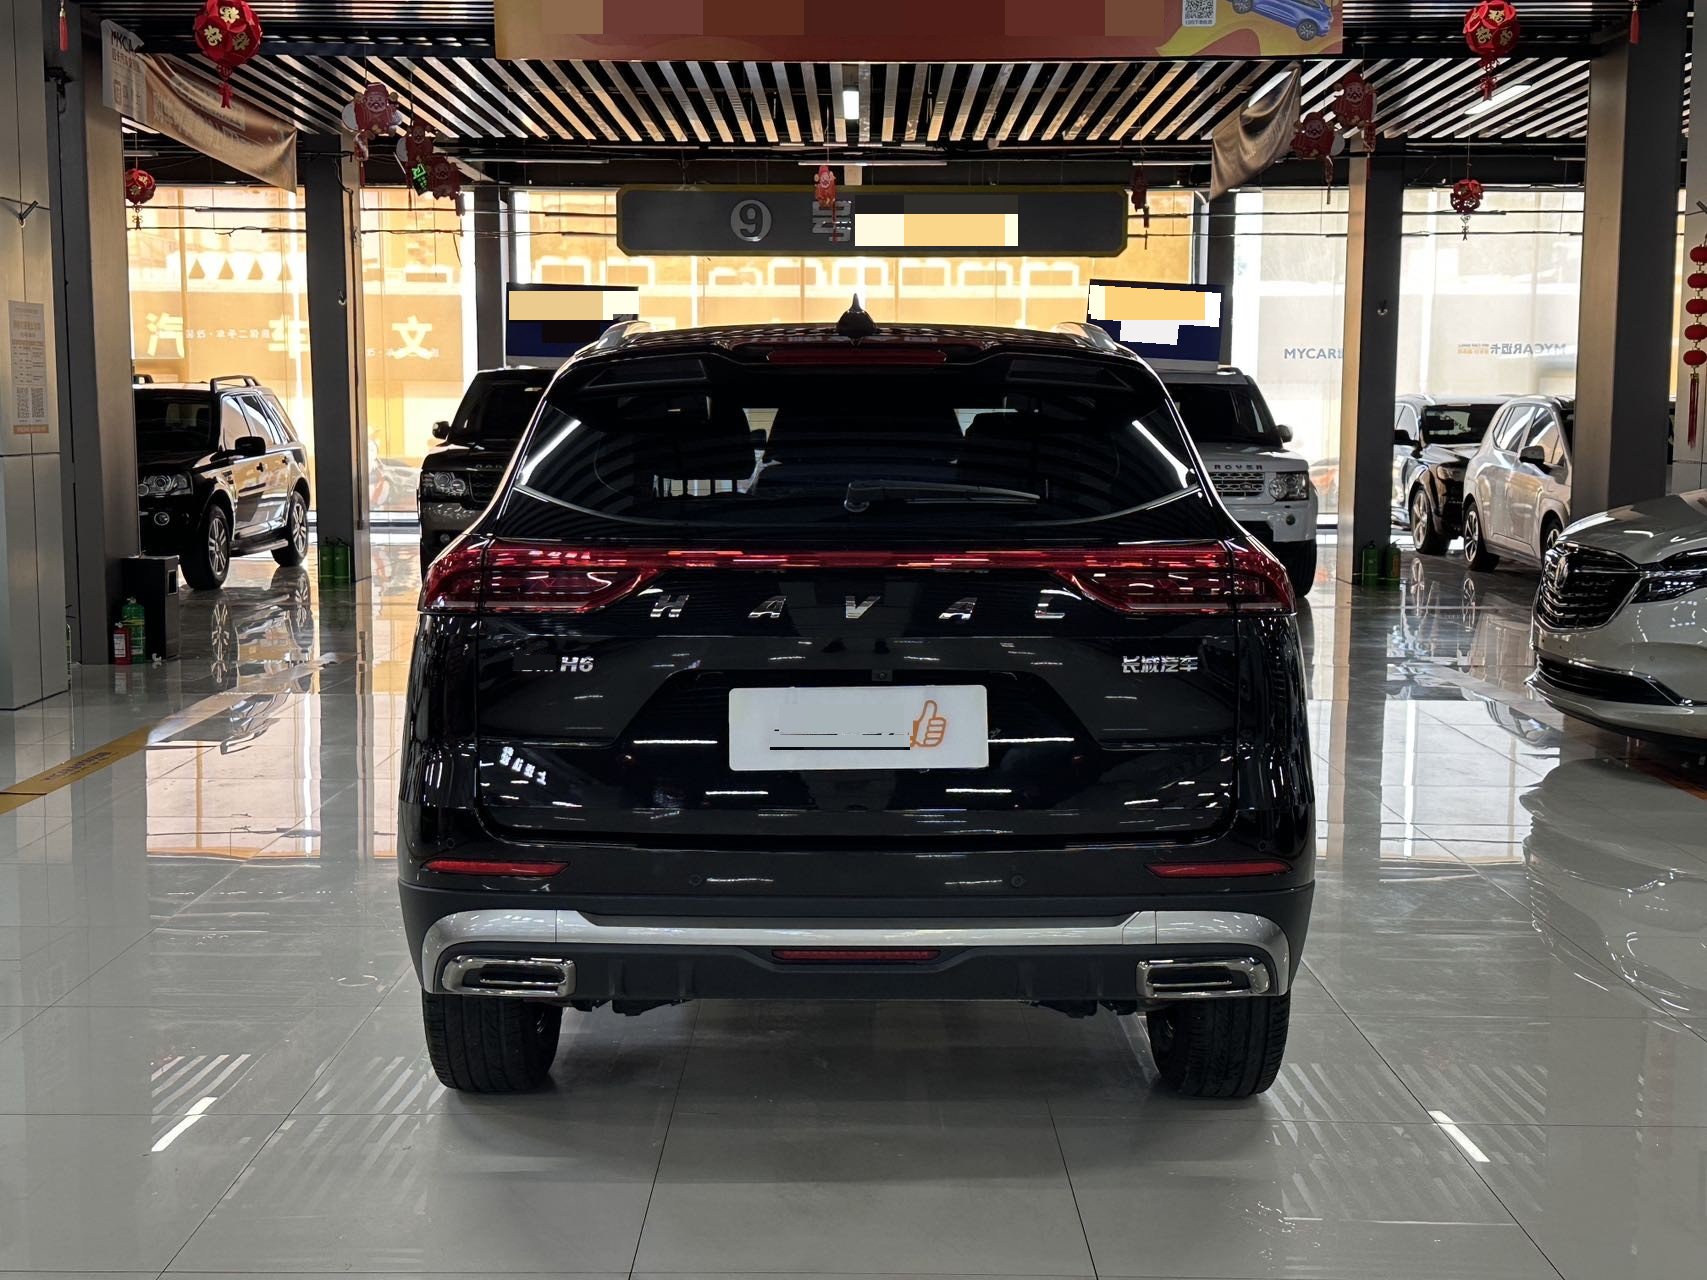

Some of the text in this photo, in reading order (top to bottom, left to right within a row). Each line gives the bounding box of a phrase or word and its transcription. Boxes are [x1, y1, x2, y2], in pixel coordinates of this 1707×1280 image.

[736, 202, 766, 238] 9
[650, 594, 1066, 619] HAVAL
[560, 656, 594, 672] H6
[1122, 655, 1198, 673] 长城汽车
